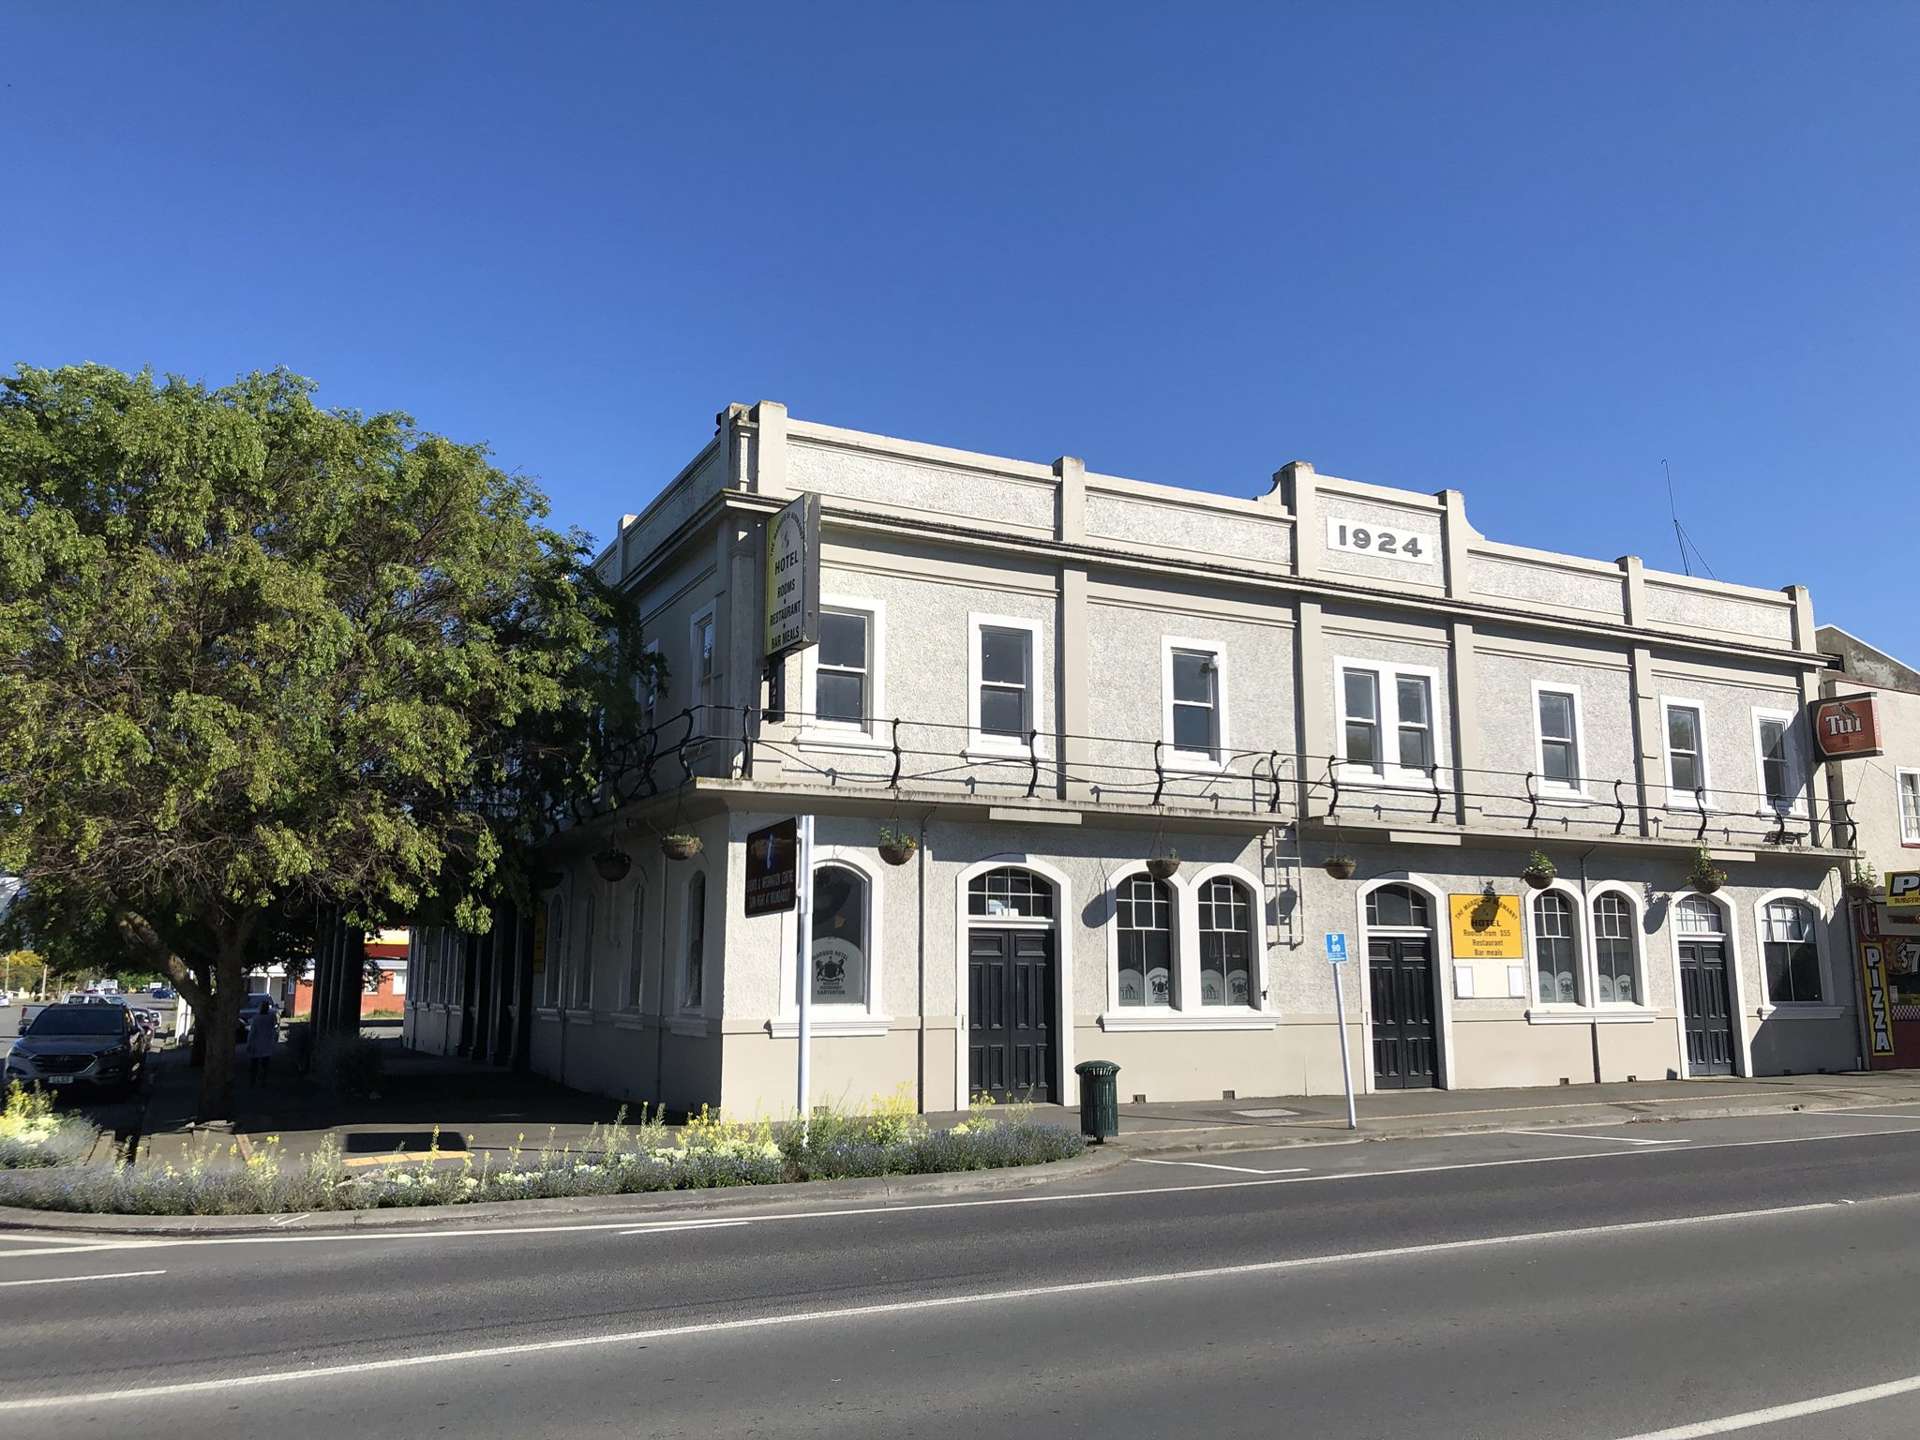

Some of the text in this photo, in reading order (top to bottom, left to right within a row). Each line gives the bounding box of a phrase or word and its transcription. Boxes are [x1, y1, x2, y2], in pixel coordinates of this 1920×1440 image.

[1339, 525, 1422, 557] 1924
[774, 550, 799, 576] HOTEL
[777, 578, 796, 598] ROOMS
[770, 600, 801, 626] RESTAURANT
[782, 625, 800, 645] MEALS
[1825, 715, 1862, 736] Tui
[1472, 919, 1502, 927] HOTEL
[1483, 929, 1497, 937] from
[1331, 935, 1339, 944] P
[1866, 947, 1891, 1051] PIZZA
